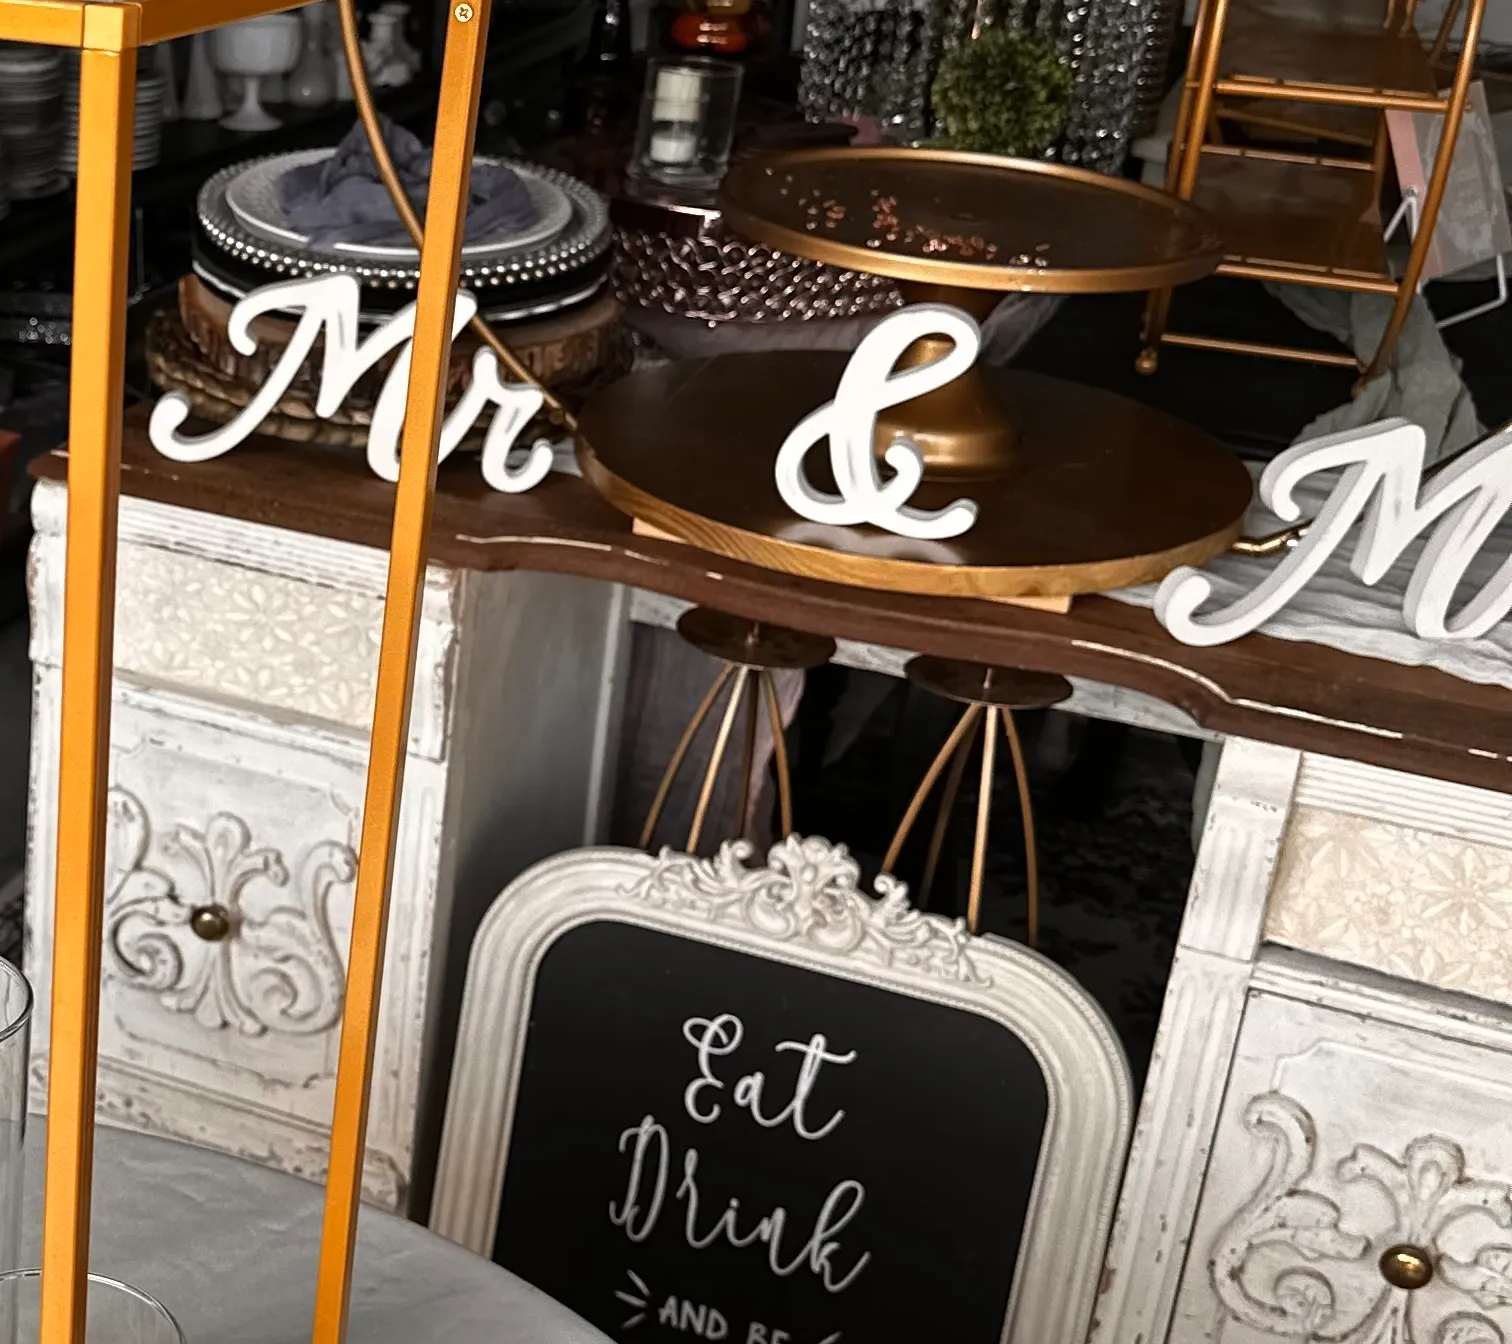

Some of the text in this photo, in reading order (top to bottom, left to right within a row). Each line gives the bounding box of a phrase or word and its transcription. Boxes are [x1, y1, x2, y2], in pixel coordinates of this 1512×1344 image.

[148, 272, 554, 494] Mr
[775, 302, 982, 540] &
[683, 1013, 857, 1140] Eat
[609, 1114, 872, 1293] Drink
[658, 1293, 729, 1341] AND
